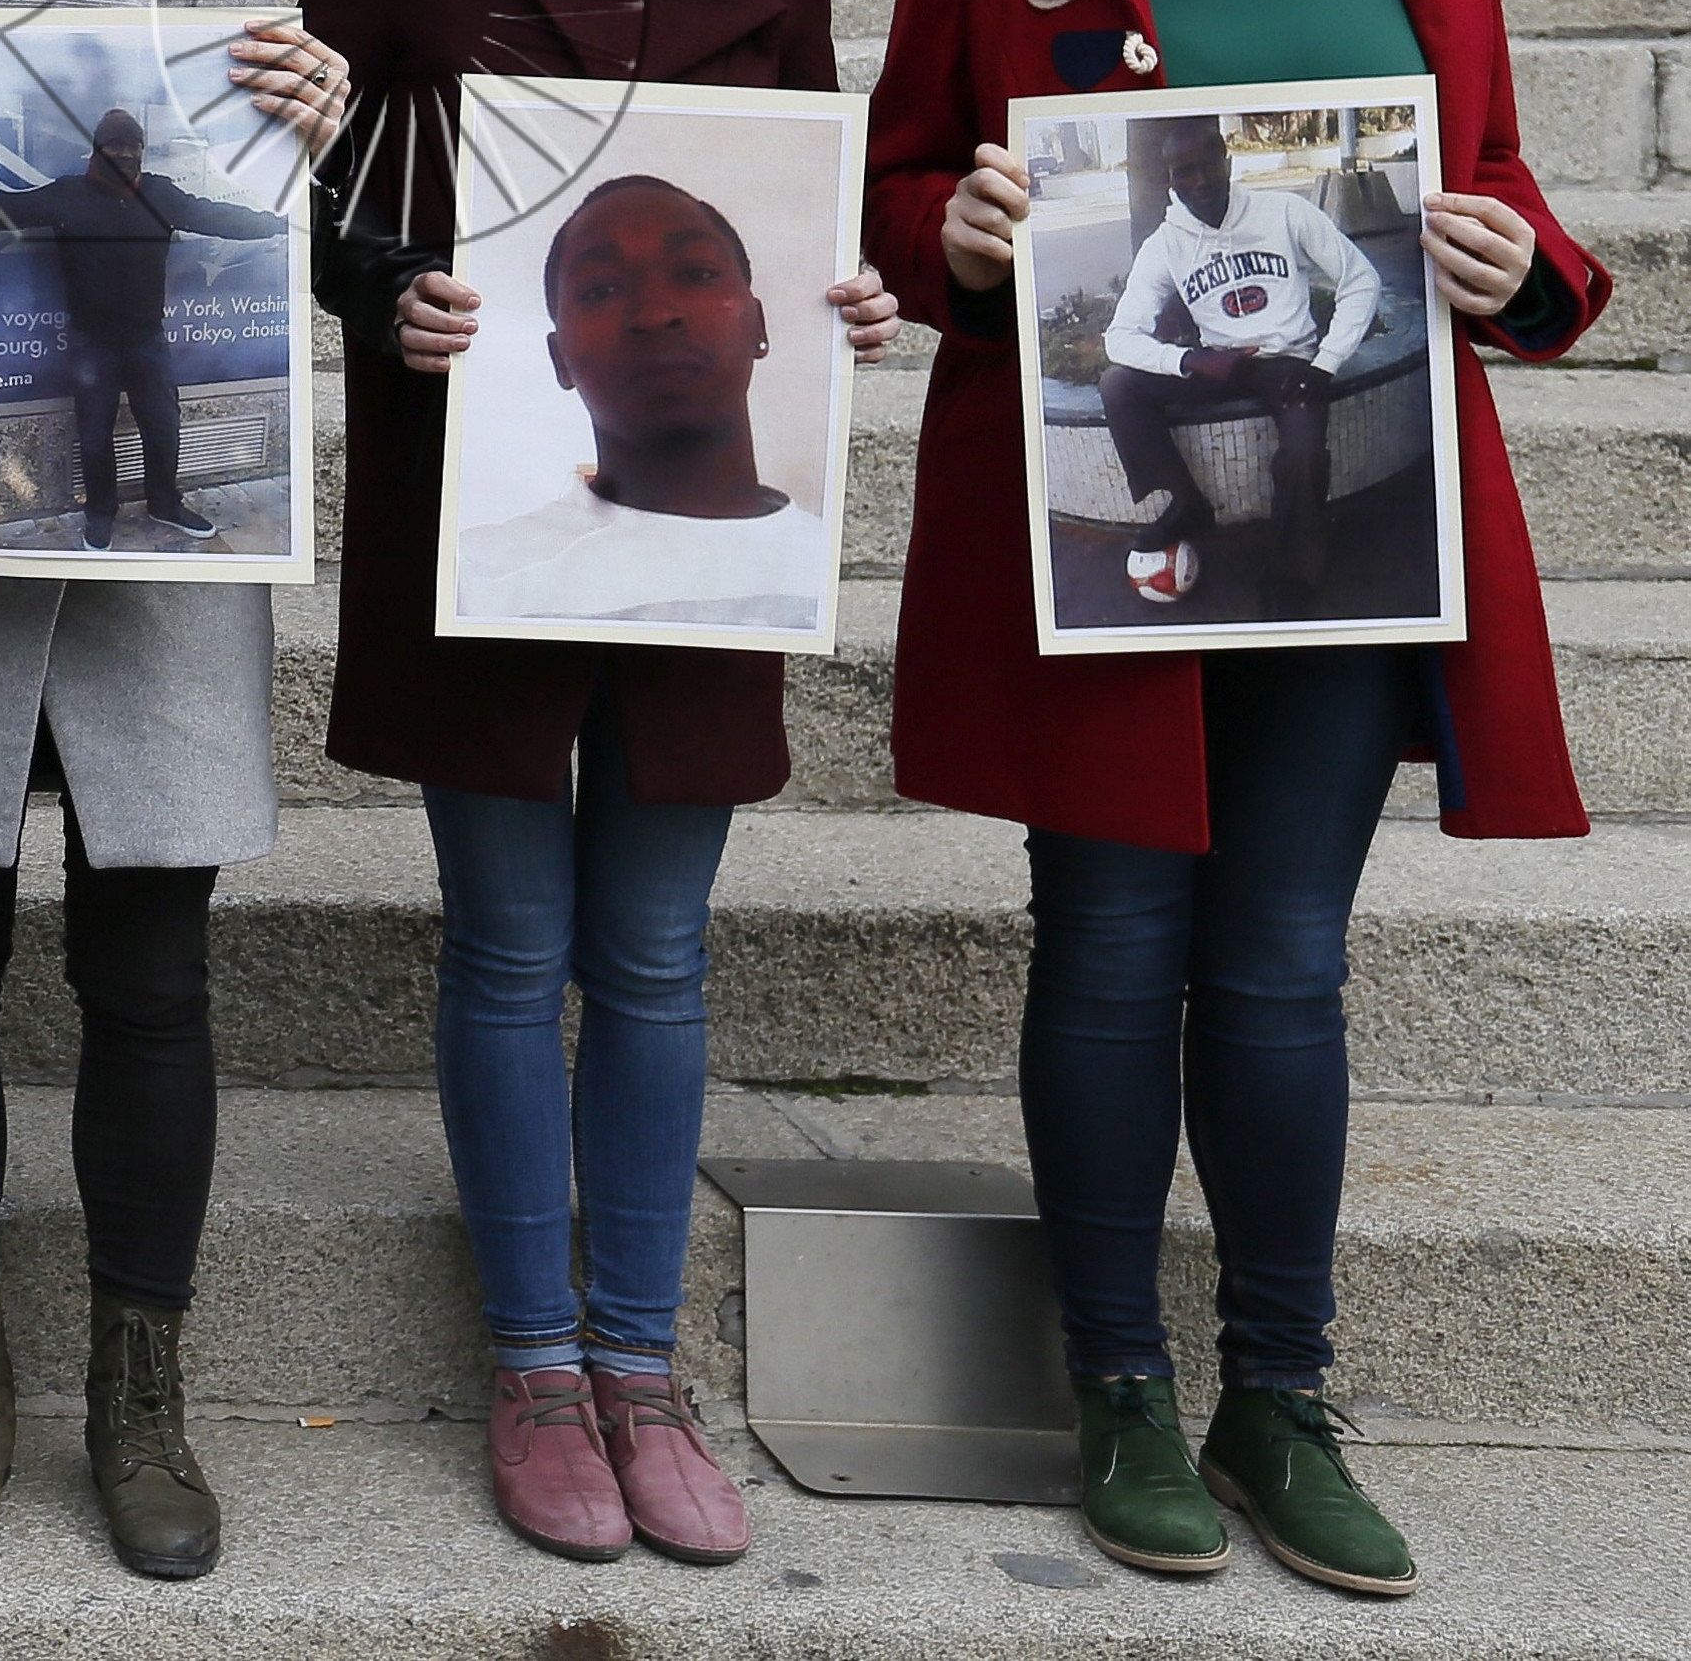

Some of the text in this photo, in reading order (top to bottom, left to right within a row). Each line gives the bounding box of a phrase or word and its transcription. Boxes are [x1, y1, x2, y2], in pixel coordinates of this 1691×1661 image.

[1, 310, 70, 331] voyag
[182, 296, 225, 319] York,
[182, 322, 237, 346] Tokyo,
